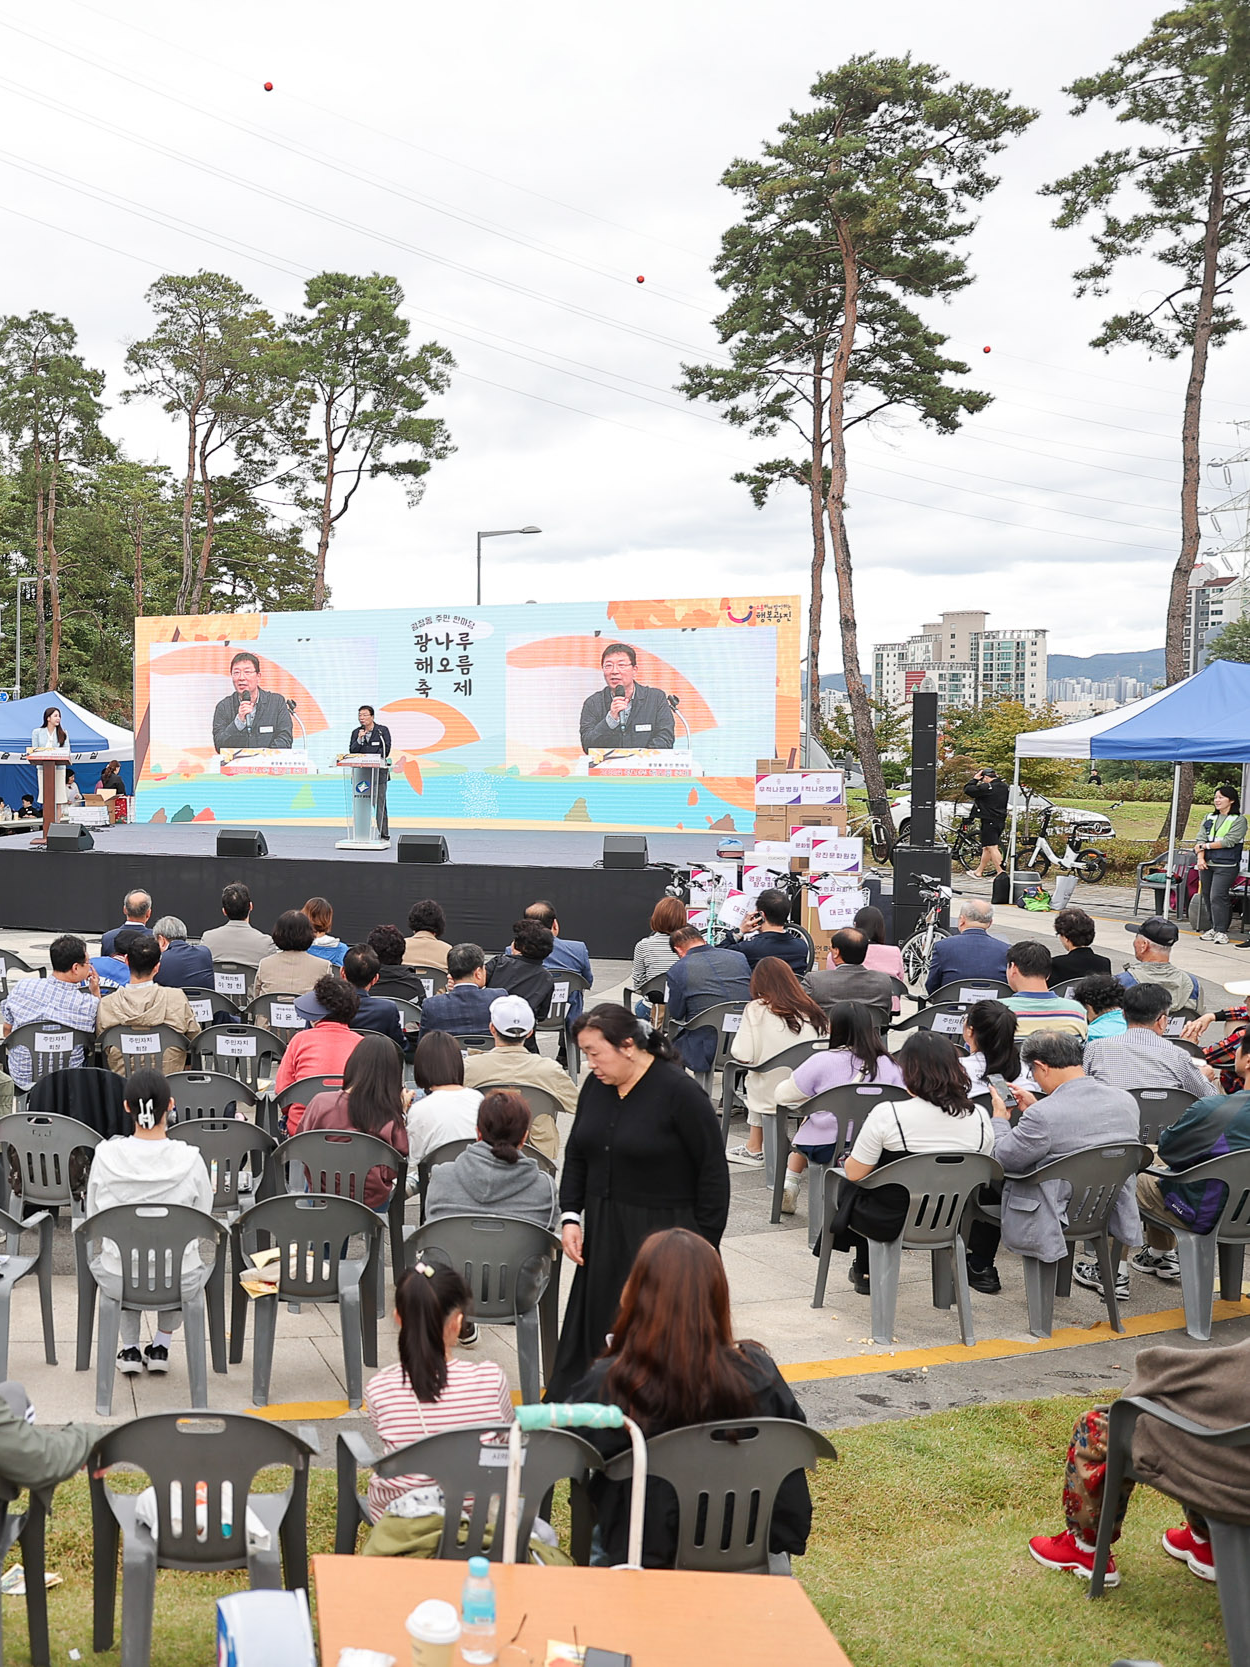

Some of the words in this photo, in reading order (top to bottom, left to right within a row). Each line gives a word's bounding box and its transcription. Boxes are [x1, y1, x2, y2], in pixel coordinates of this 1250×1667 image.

[410, 616, 433, 631] 광장동
[435, 614, 450, 623] 주민
[453, 615, 476, 630] 한마당
[756, 610, 791, 623] 행복광진
[414, 632, 474, 653] 광나루
[414, 655, 474, 676] 해오름
[815, 851, 857, 860] 광진문화원장
